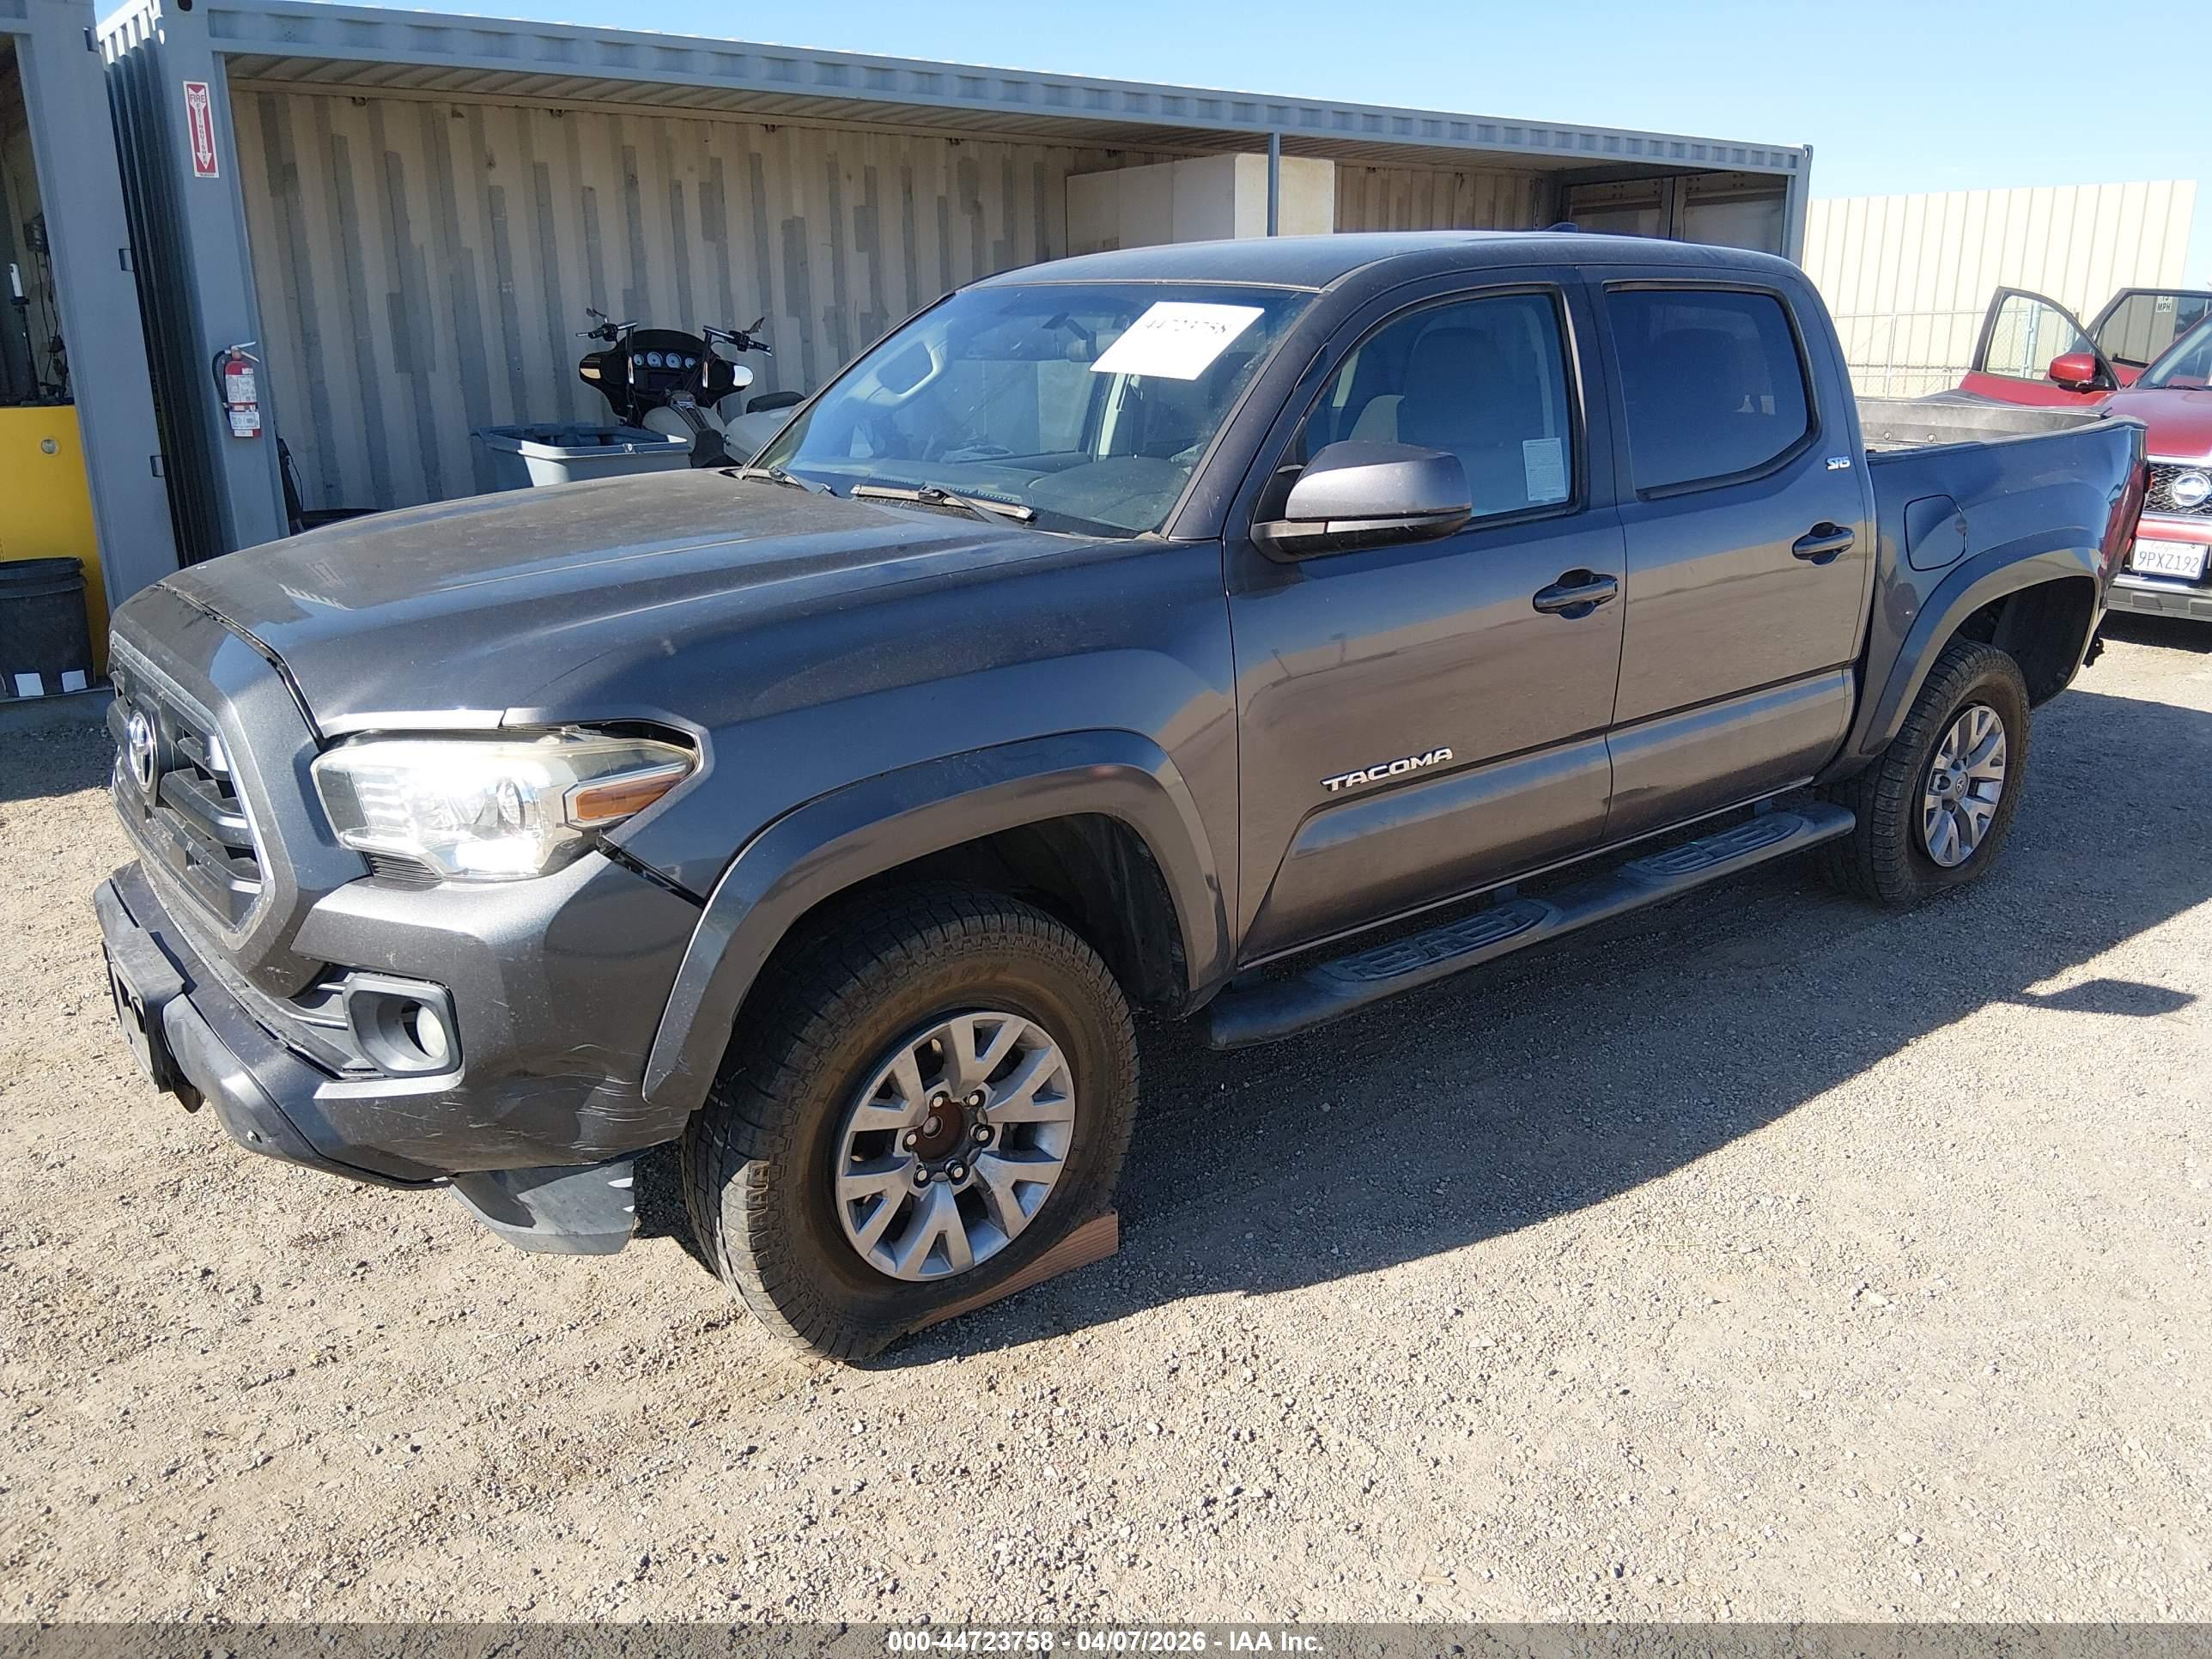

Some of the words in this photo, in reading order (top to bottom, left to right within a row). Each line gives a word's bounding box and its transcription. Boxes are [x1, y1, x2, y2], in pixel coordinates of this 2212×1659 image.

[190, 94, 206, 103] FIRE
[196, 103, 208, 165] EXTINGUISHER
[2138, 550, 2199, 573] 9PXZ192
[1321, 747, 1453, 792] TACOMA
